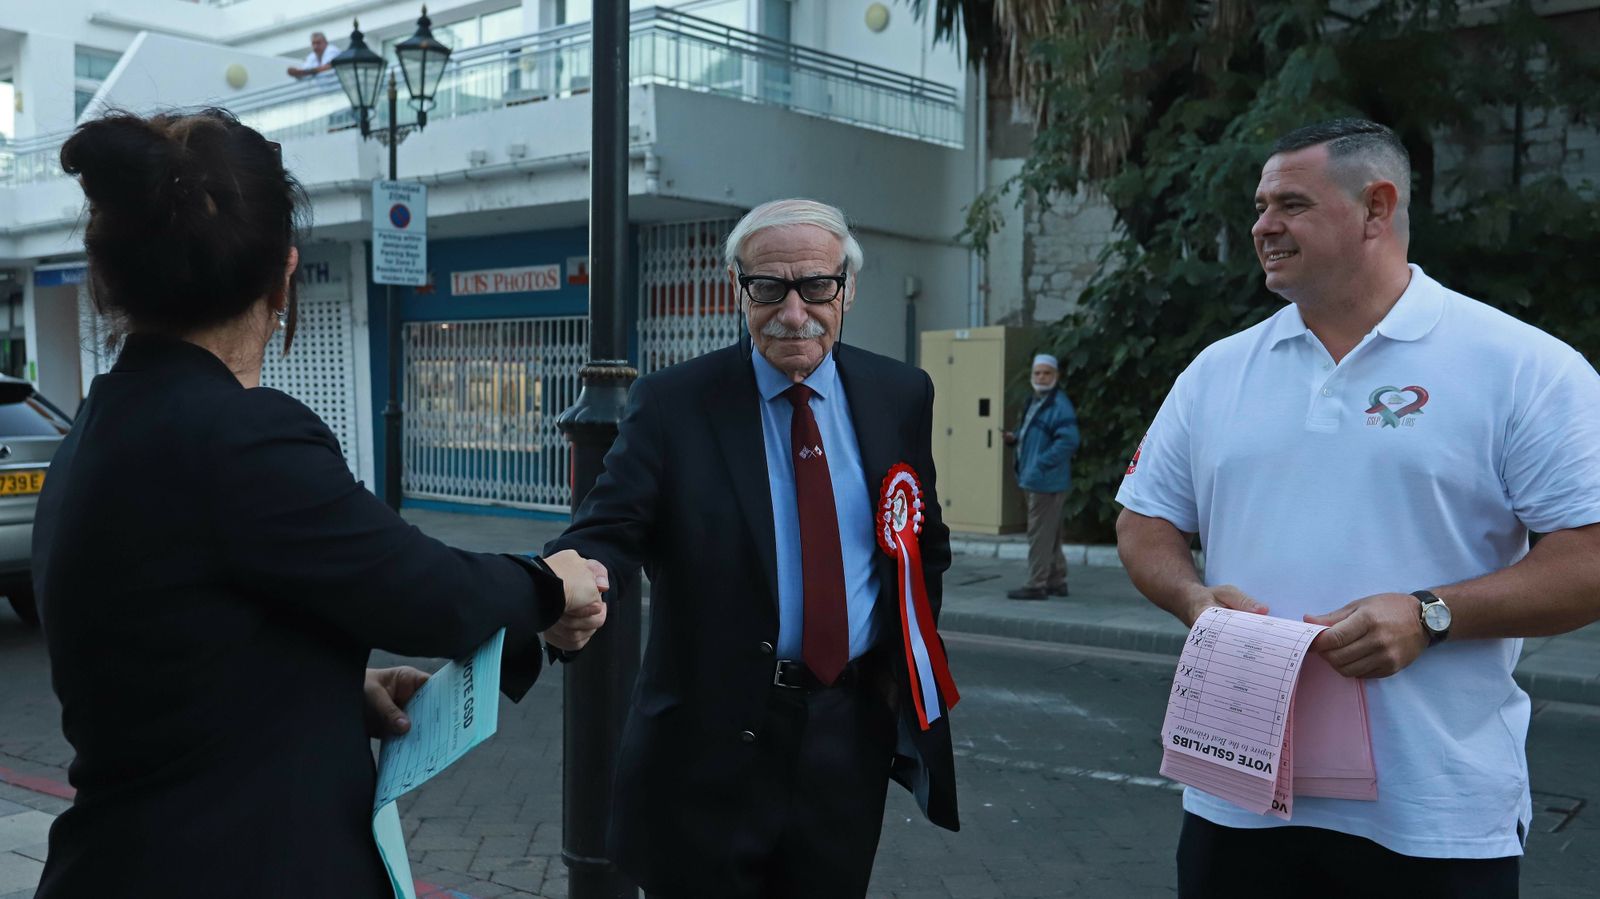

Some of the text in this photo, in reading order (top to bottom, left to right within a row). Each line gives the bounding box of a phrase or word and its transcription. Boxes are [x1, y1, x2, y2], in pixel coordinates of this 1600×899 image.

[454, 268, 558, 295] LUIS PHOTOS
[463, 657, 474, 730] VOTE GSD
[1172, 734, 1273, 774] VOTE GSLP/LIBS
[1175, 724, 1276, 760] Aspire to the Best Gibraltar
